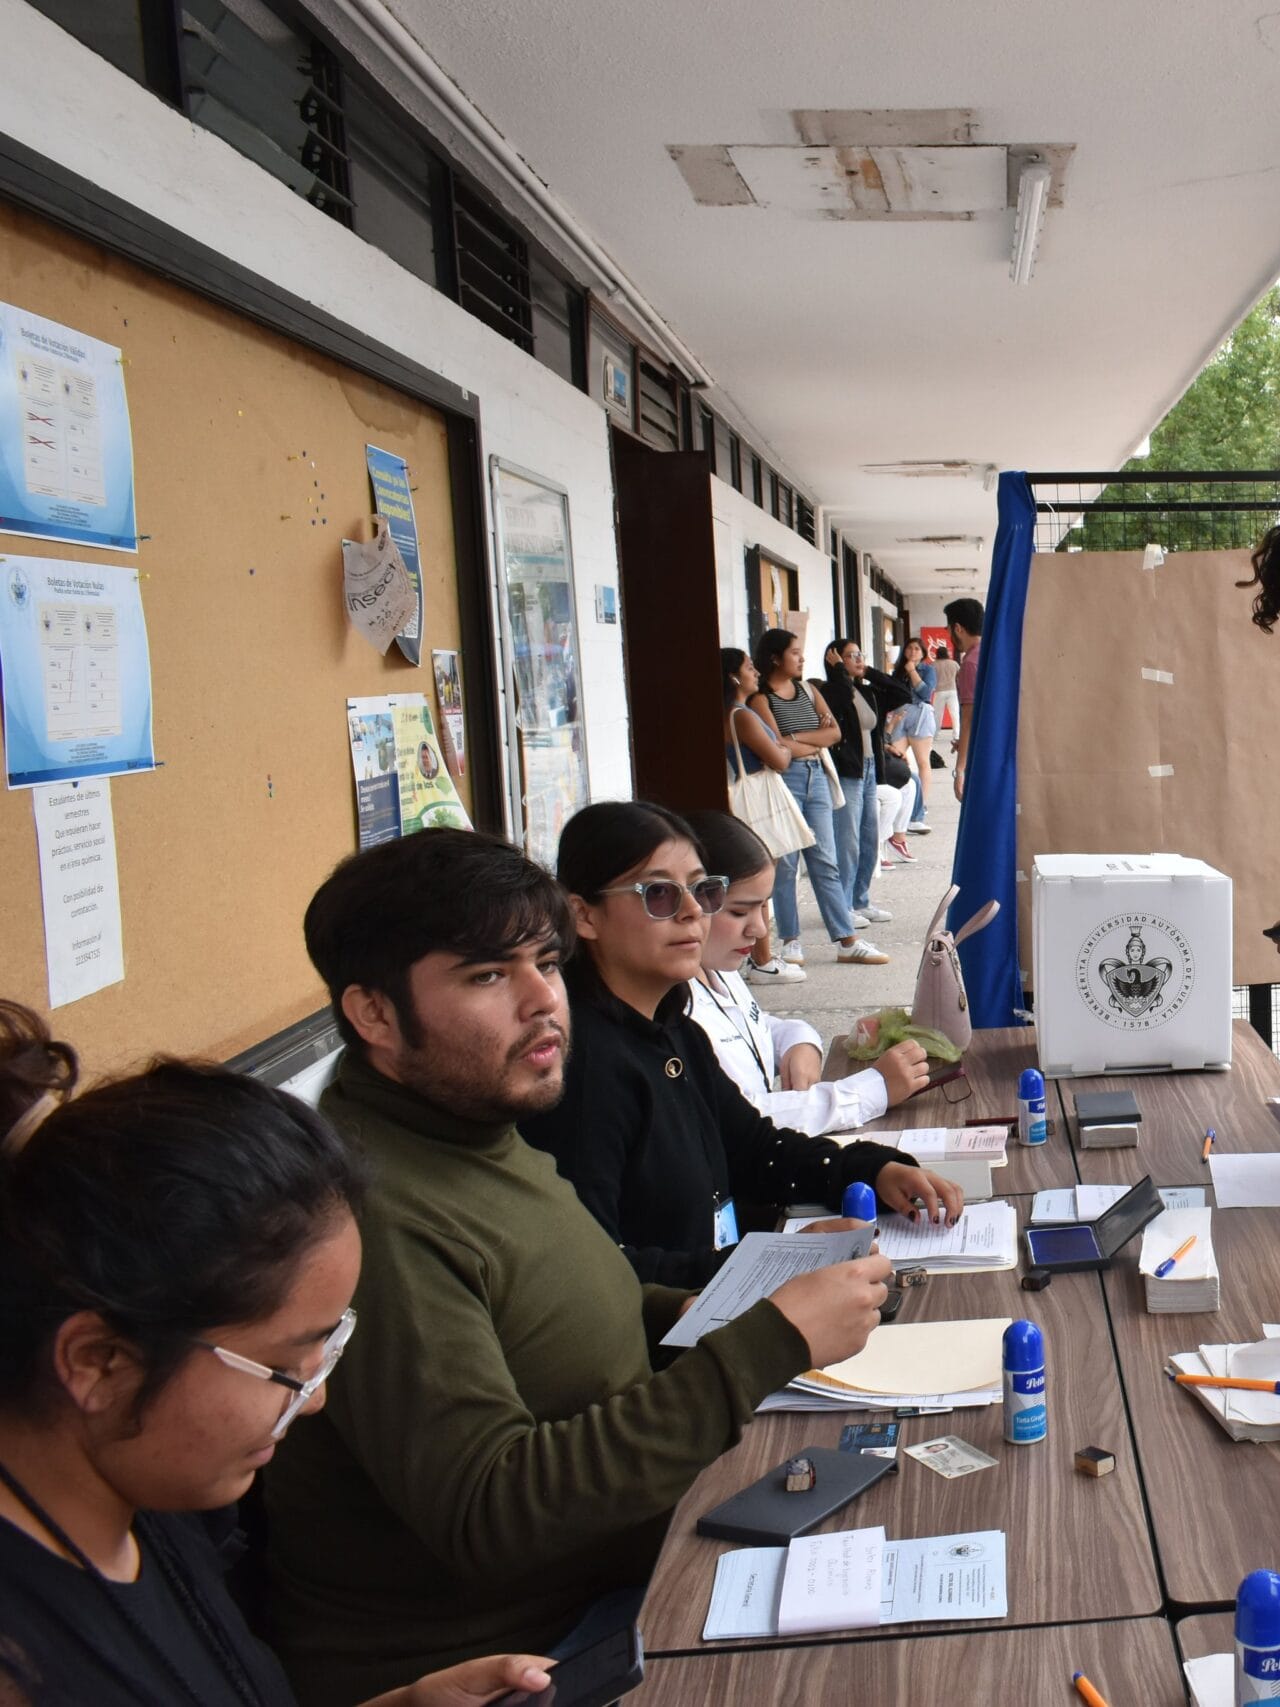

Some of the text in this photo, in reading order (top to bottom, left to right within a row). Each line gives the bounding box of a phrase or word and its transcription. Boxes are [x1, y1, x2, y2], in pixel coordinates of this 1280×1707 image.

[1080, 916, 1192, 1020] BENEMÉRITA UNIVERSIDAD AUTÓNOMA DE PUEBLA
